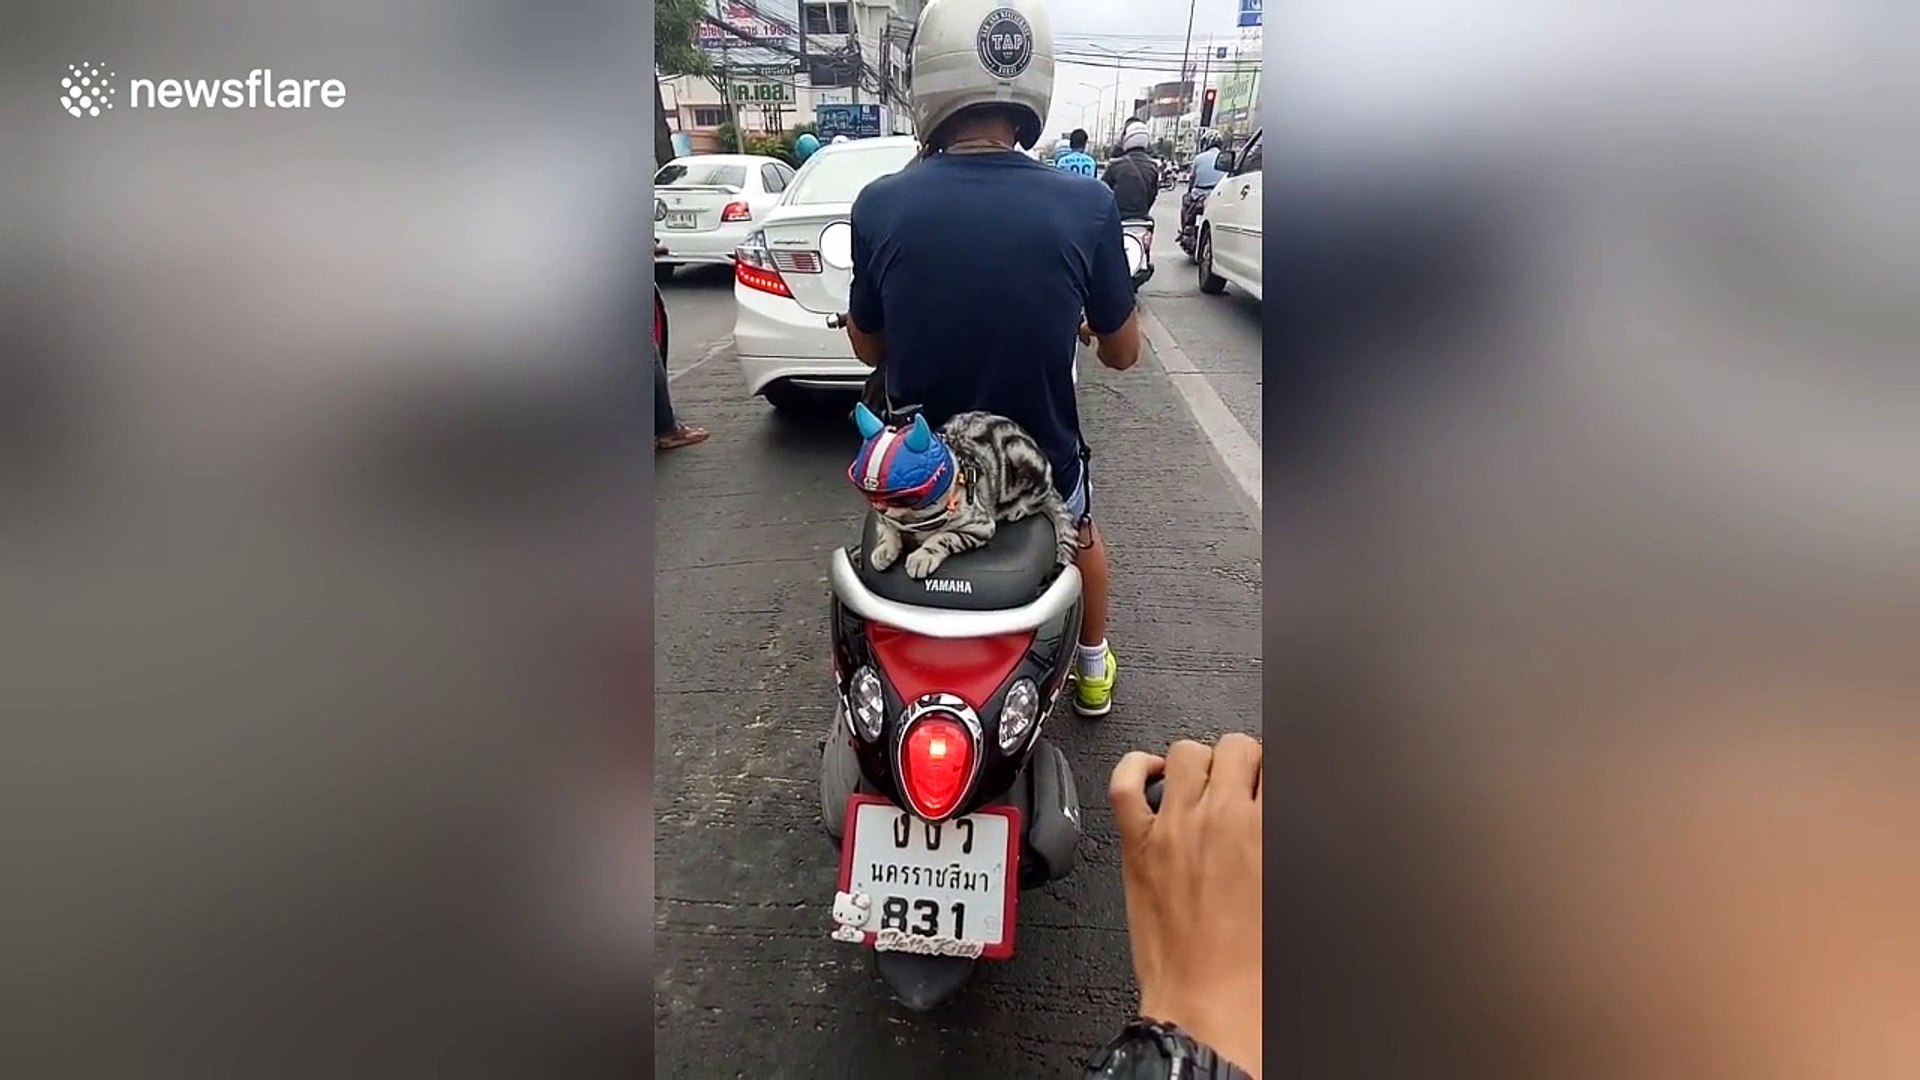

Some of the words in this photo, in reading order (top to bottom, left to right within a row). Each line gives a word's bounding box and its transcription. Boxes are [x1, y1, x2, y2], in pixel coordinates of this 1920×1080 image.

[991, 32, 1023, 51] TAP
[924, 578, 973, 594] YAMAHA
[871, 863, 989, 892] นครราชสีมา
[881, 896, 966, 940] 831
